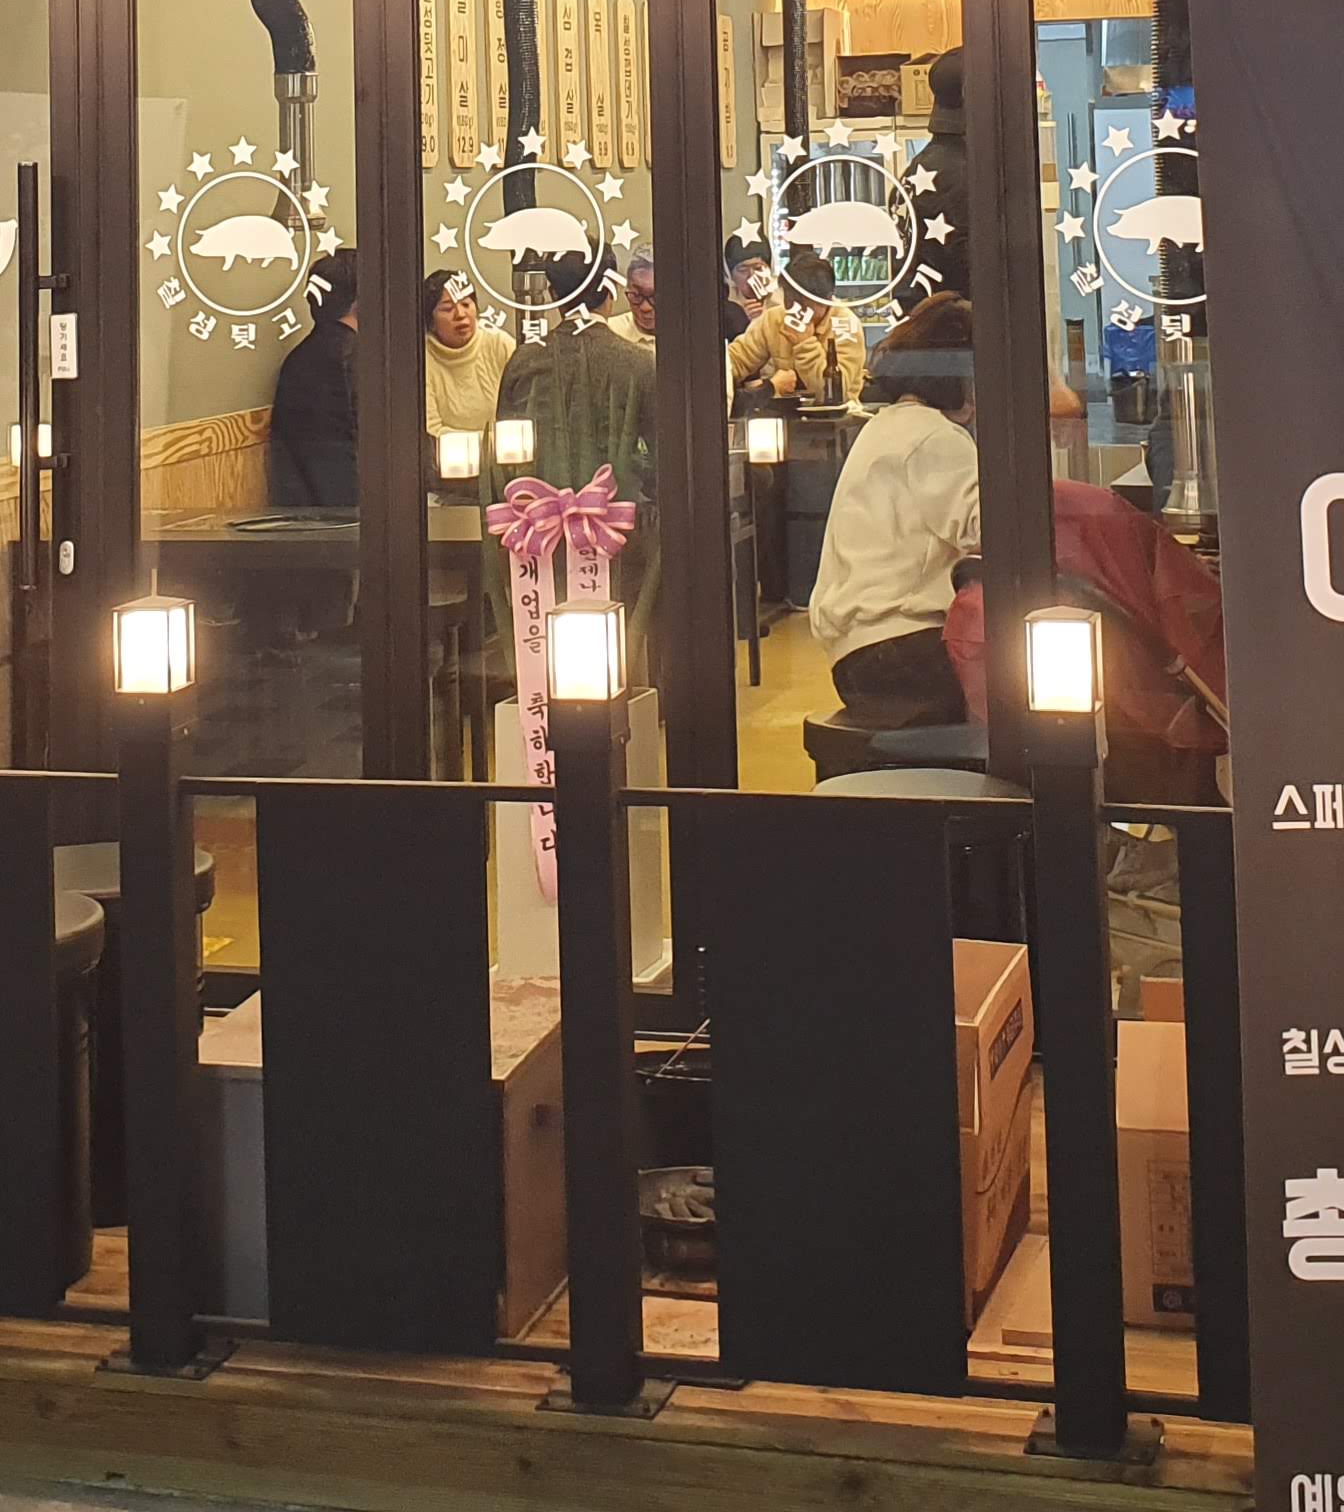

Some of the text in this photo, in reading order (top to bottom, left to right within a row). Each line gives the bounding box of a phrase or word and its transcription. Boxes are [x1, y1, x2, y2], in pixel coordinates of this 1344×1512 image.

[156, 273, 333, 351] 칠성뒷고기
[442, 267, 628, 347] 칠성뒷고기
[1069, 261, 1193, 343] 칠성뒷
[519, 555, 547, 654] 개업을
